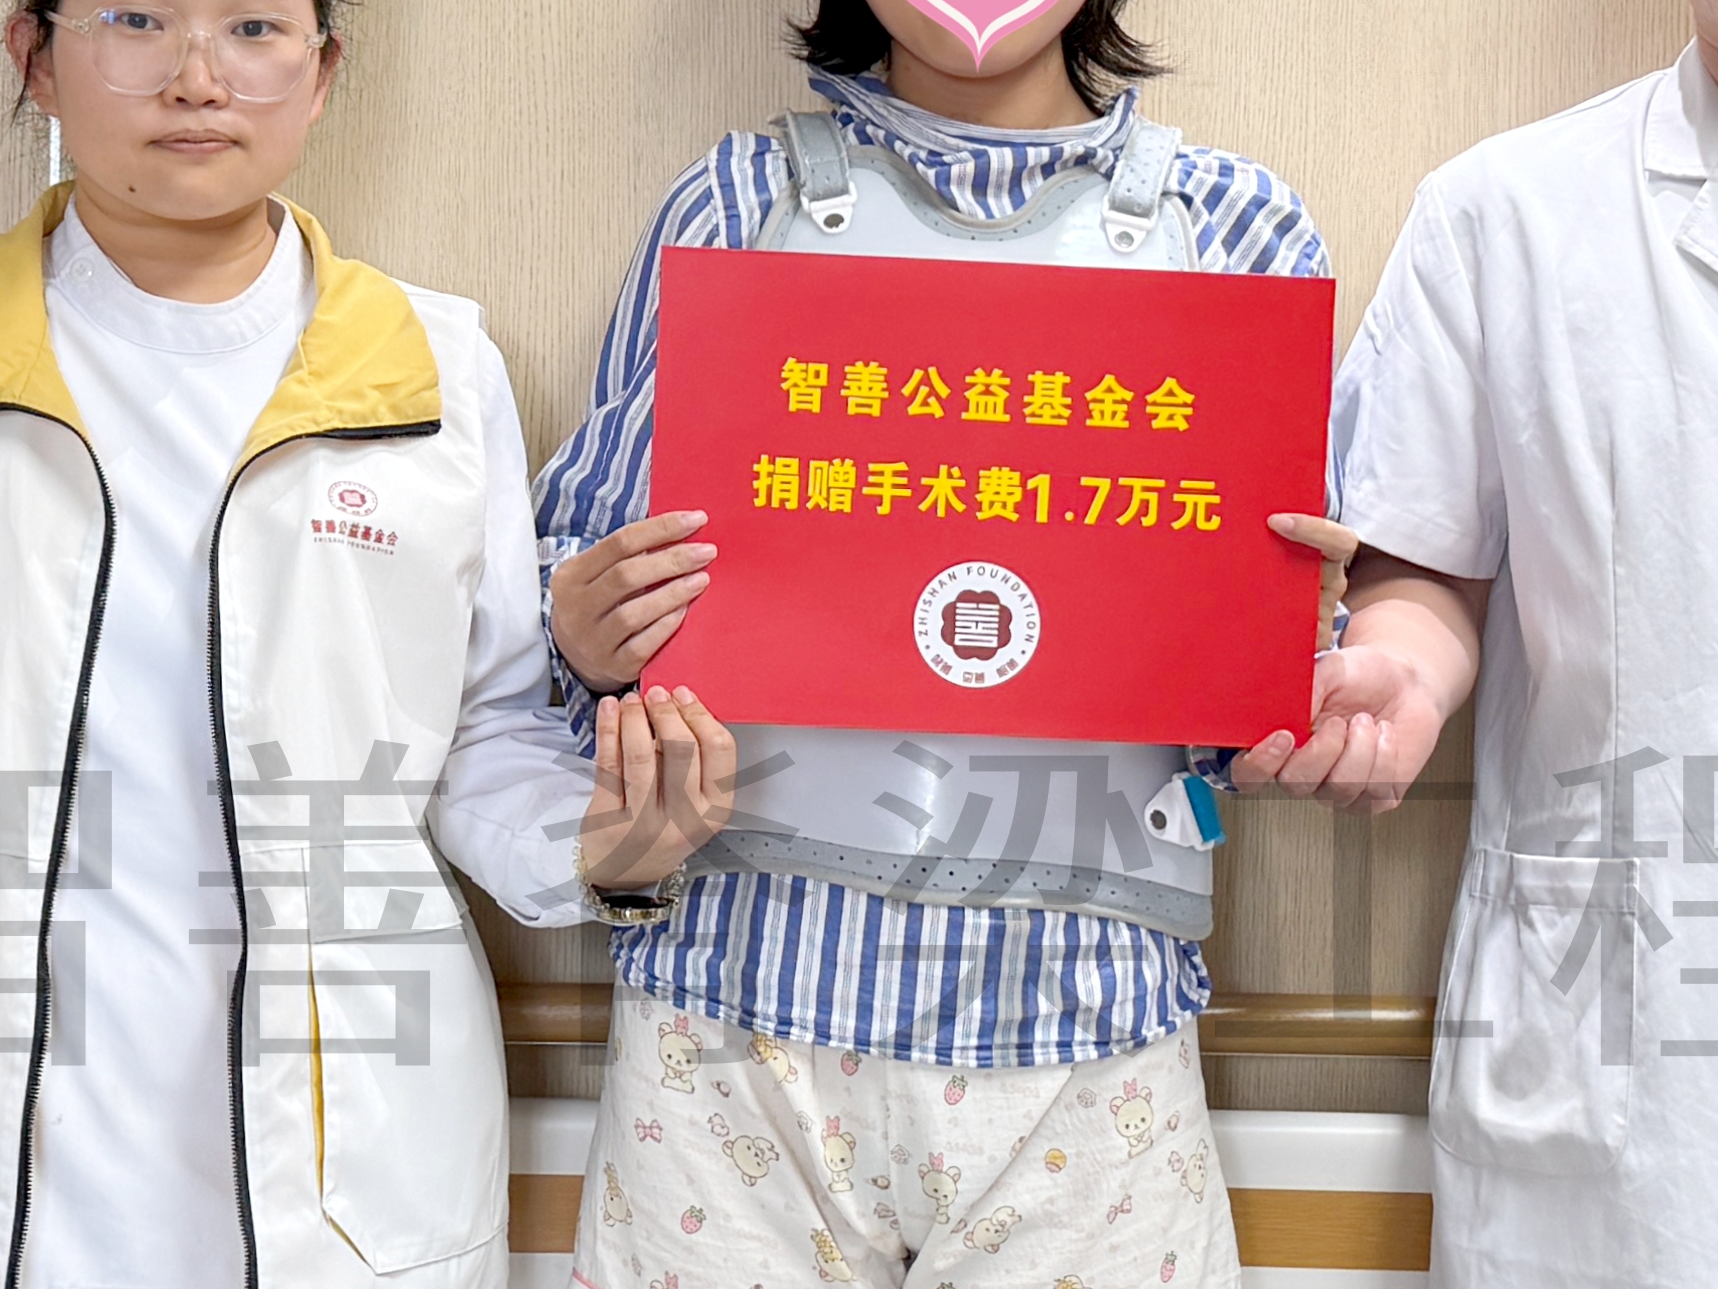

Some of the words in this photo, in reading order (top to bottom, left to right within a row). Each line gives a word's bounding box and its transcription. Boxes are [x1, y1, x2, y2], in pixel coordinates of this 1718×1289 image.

[780, 357, 1195, 431] 智善公益基金会
[752, 454, 1222, 531] 捐赠手术费1.7万元
[918, 571, 958, 637] ZHISHAN
[966, 566, 1037, 643] FOUNDATION
